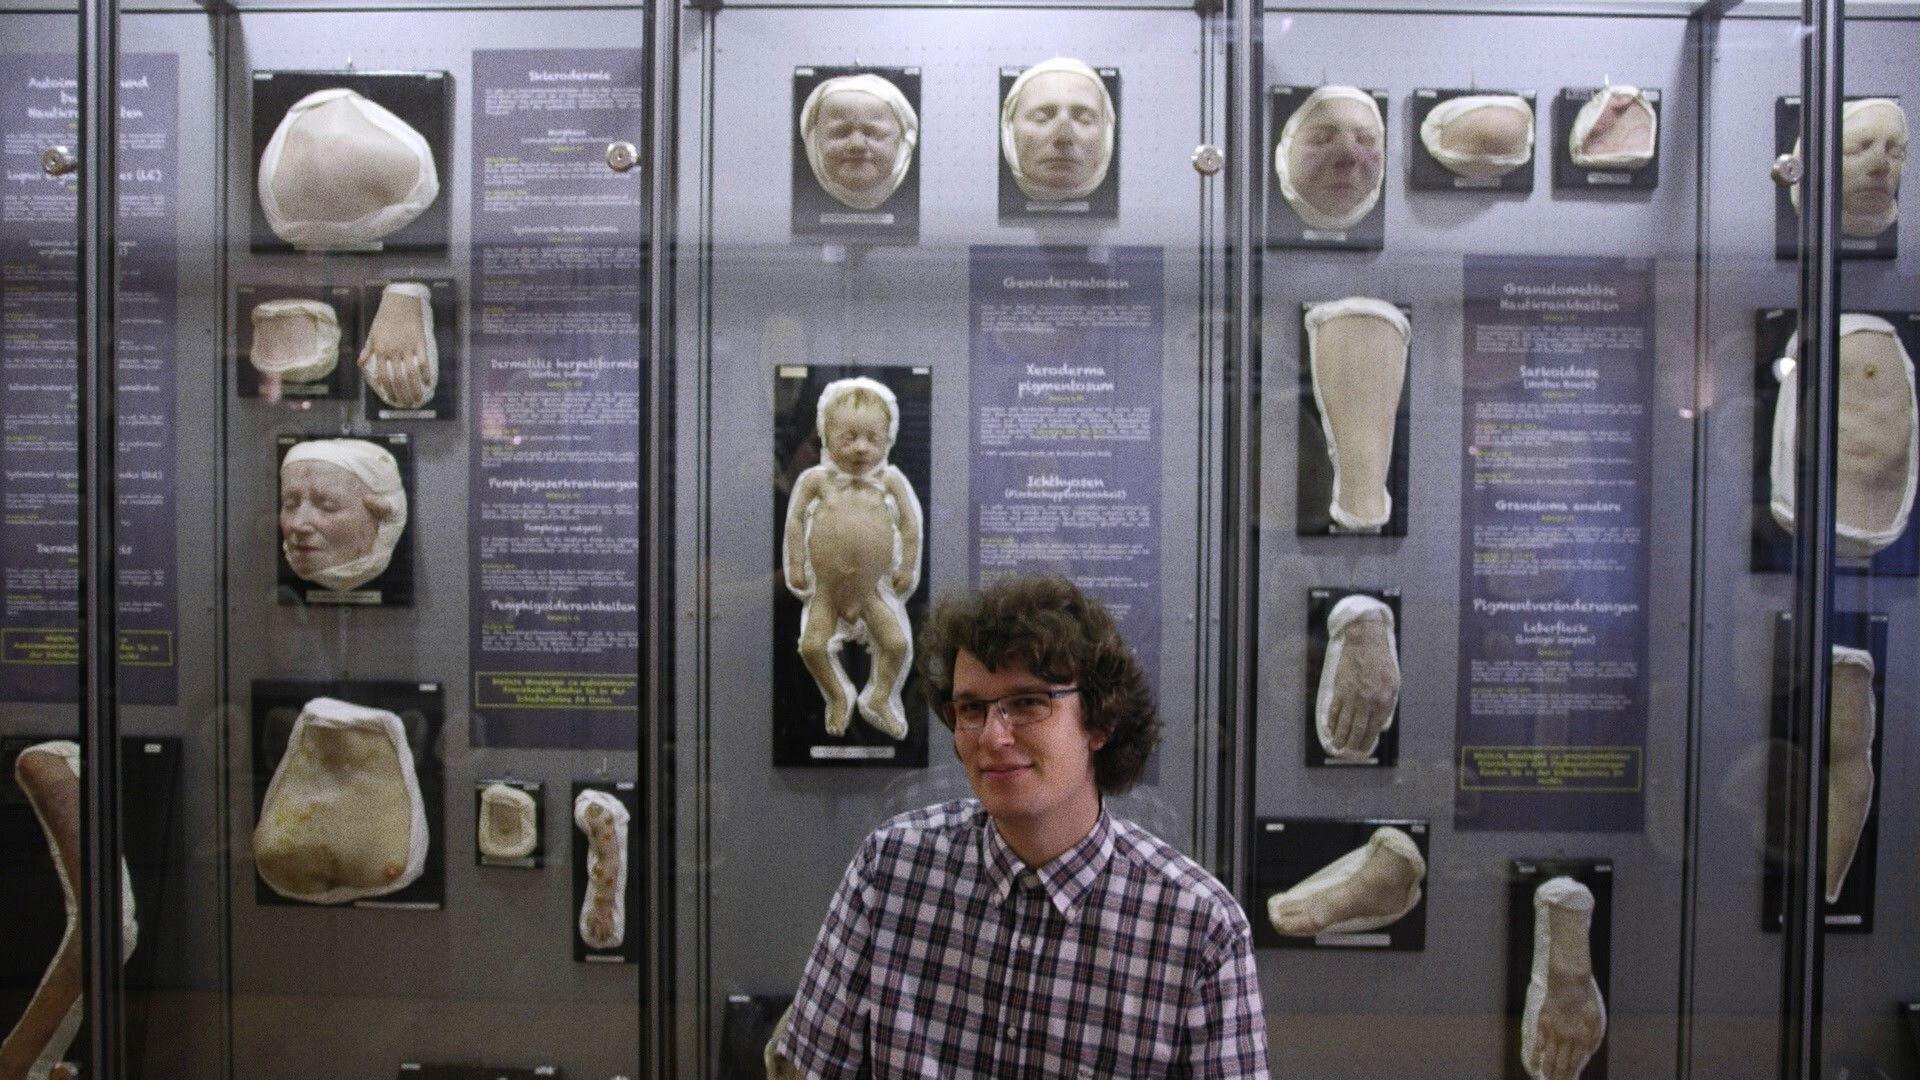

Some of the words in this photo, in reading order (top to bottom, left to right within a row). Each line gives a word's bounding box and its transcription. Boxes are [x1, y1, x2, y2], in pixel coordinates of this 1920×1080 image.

[1003, 276, 1129, 289] Genodermatosen
[1026, 363, 1105, 376] Xeroderma
[1520, 366, 1599, 378] Sarkoidose
[1018, 379, 1114, 398] pigmentosum
